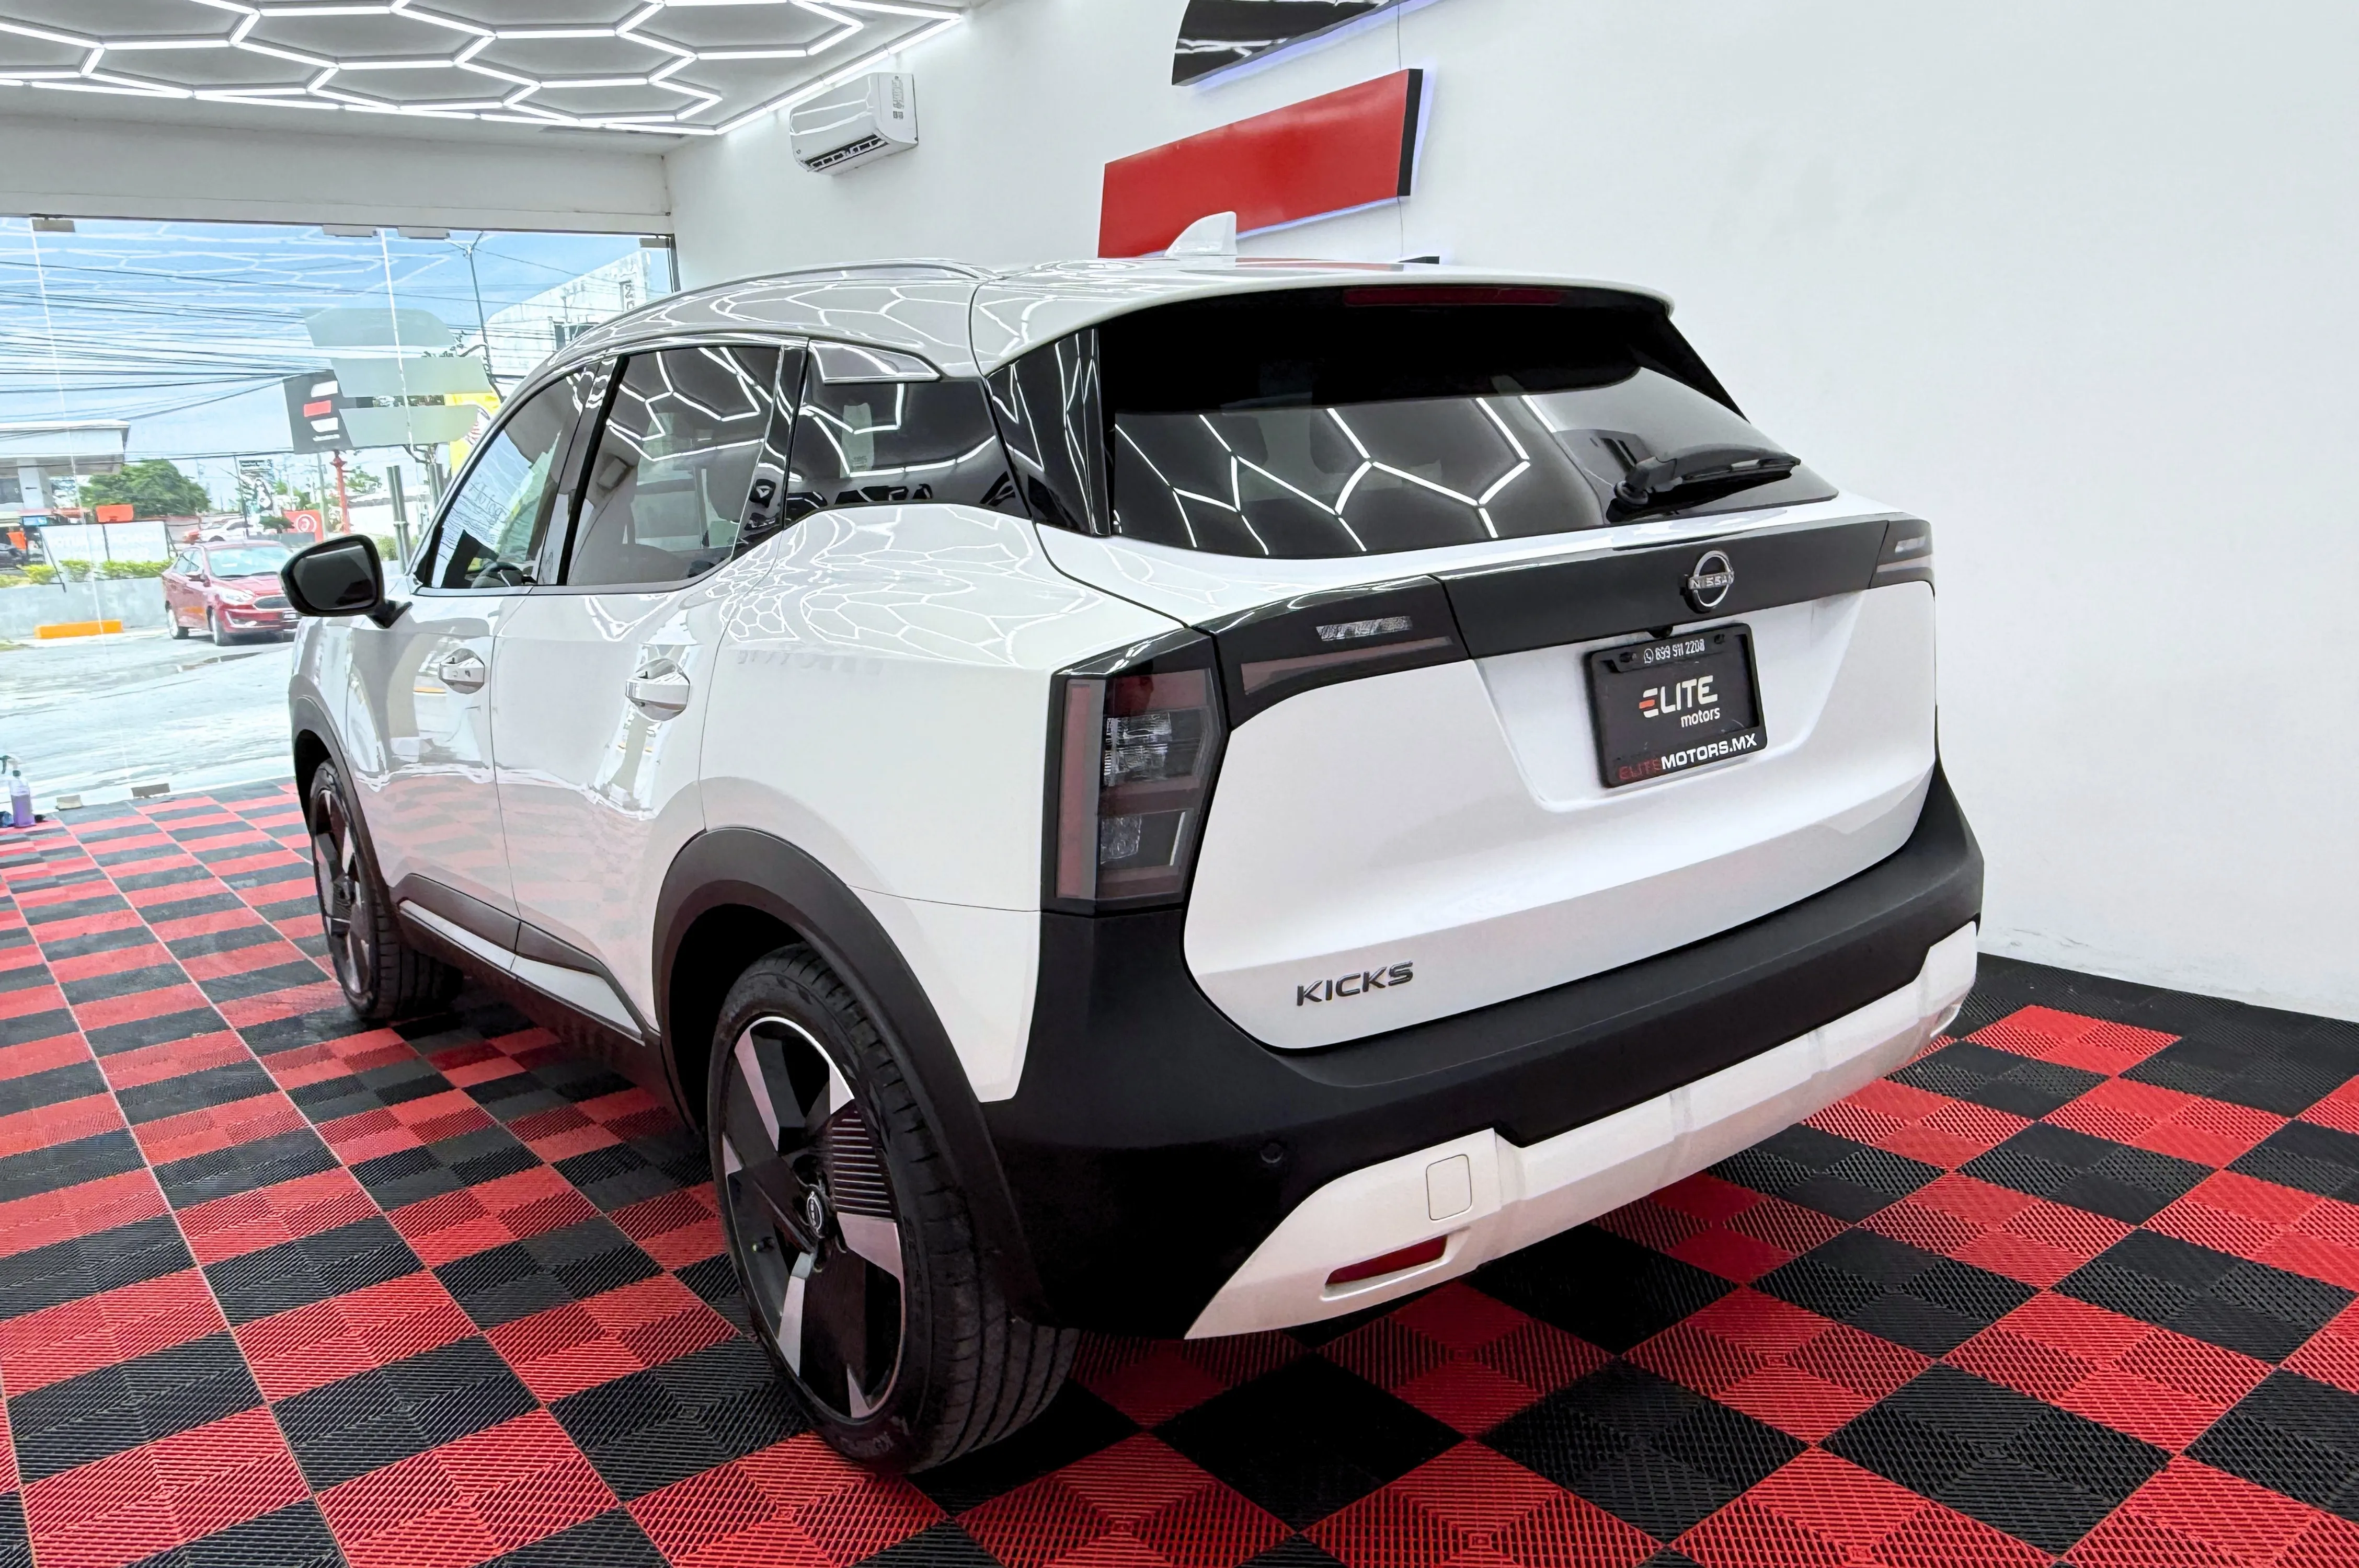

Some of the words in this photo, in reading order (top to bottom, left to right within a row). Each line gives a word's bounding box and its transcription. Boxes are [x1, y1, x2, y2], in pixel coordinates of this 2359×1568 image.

[1639, 675, 1718, 718] ELITE
[1680, 707, 1720, 728] motors
[1296, 960, 1413, 1006] KICKS
